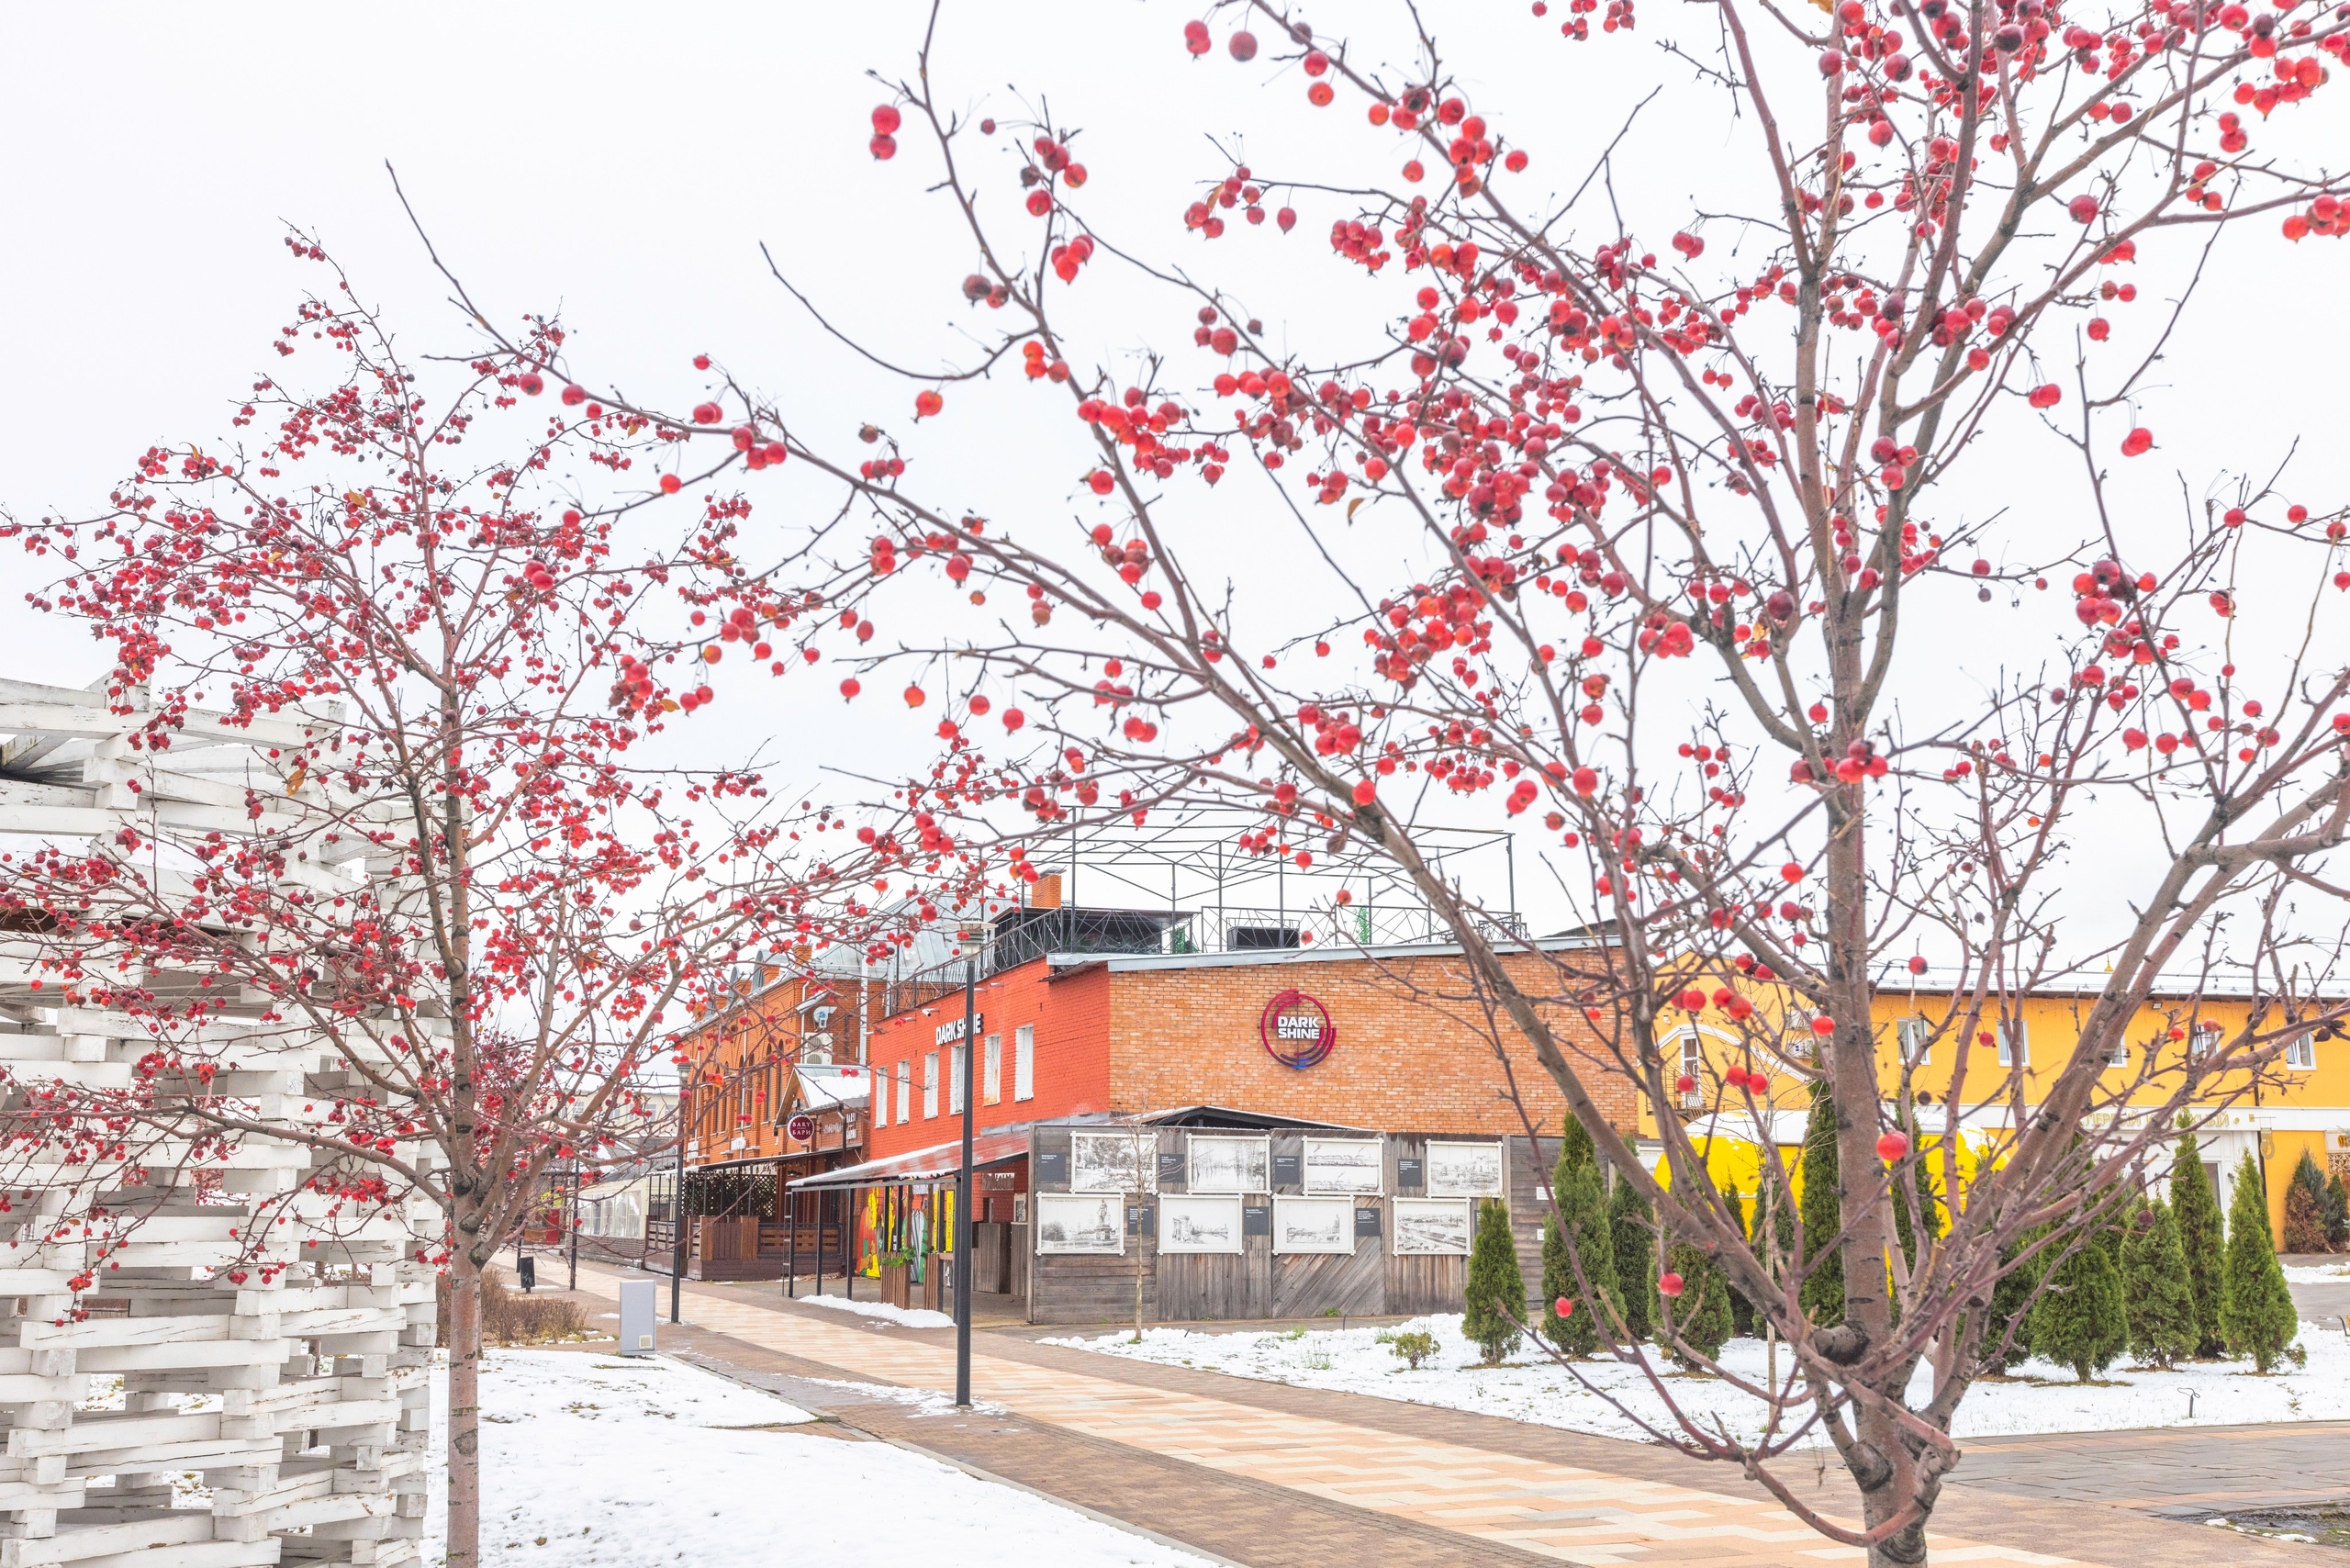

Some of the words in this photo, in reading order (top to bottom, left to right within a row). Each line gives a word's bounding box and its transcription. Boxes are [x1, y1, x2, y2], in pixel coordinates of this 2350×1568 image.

[1278, 1016, 1319, 1028] DARK
[935, 1021, 957, 1046] DARK
[957, 1013, 982, 1039] SHE
[1278, 1028, 1320, 1039] SHINE
